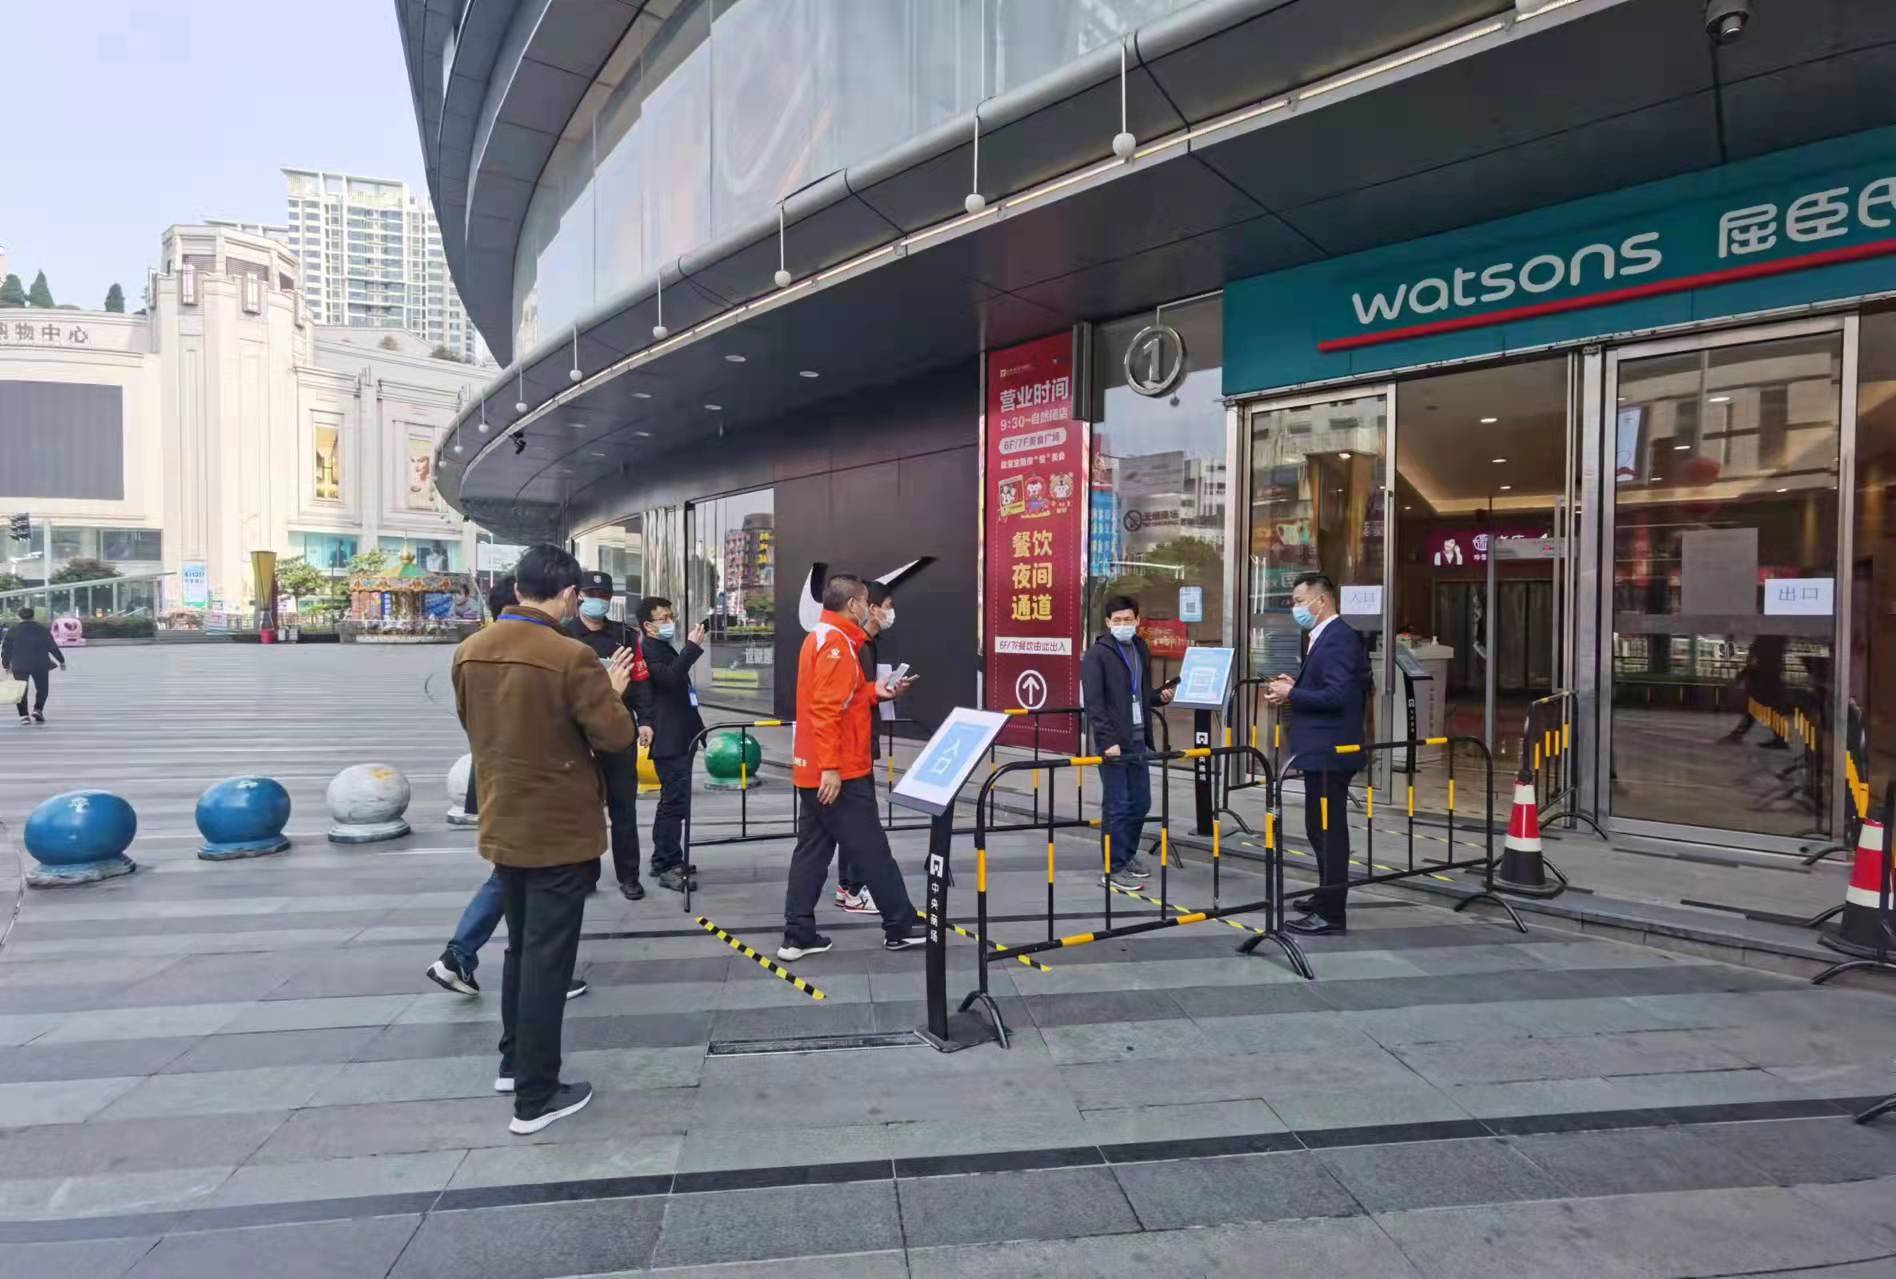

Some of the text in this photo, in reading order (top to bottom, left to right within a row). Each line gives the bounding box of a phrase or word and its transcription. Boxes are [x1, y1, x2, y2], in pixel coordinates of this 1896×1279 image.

[1352, 231, 1663, 324] watsons
[1000, 376, 1069, 413] 营业时间
[1012, 530, 1052, 558] 餐饮
[1012, 562, 1052, 589] 夜间
[1779, 585, 1818, 600] 出口
[1011, 594, 1052, 621] 通道
